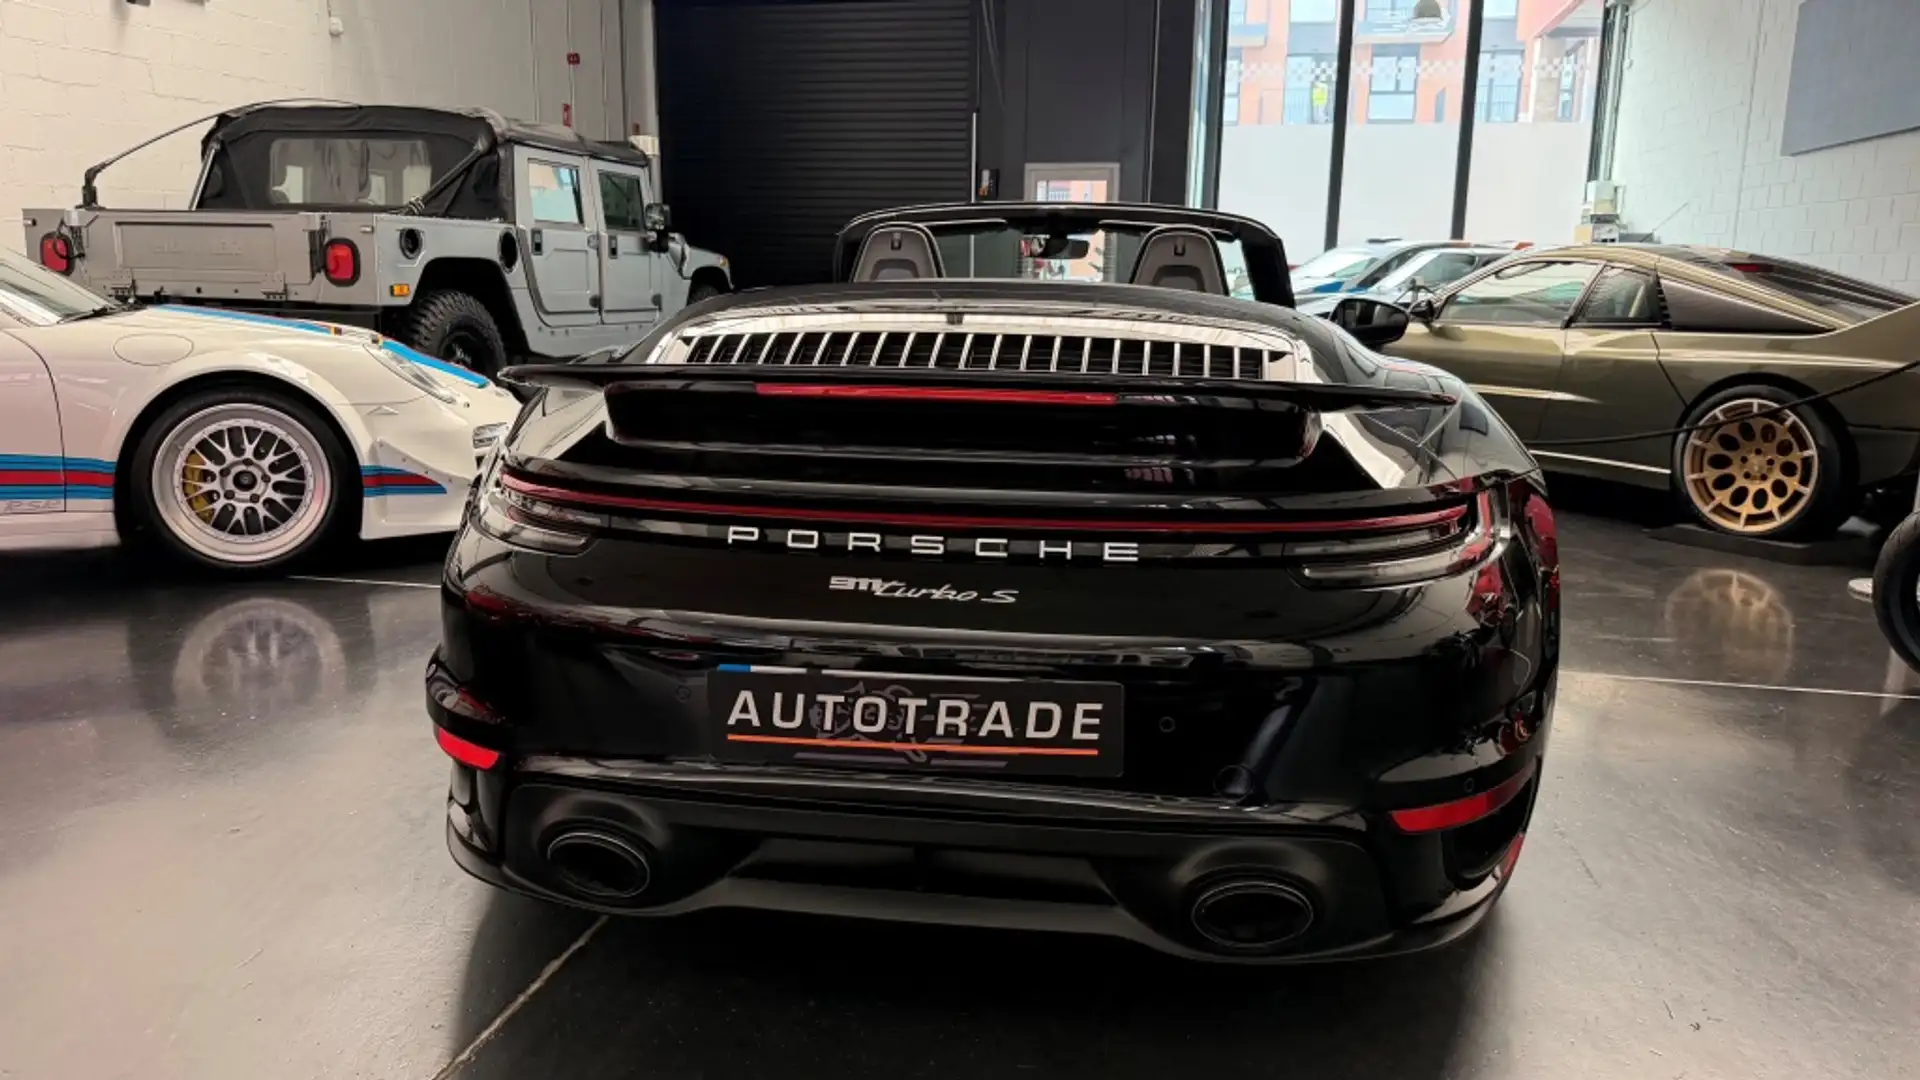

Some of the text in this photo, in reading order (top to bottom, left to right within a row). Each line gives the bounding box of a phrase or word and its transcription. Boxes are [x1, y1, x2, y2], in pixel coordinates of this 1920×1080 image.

[727, 525, 1139, 561] PORSCHE
[873, 580, 978, 601] turbo
[980, 590, 1019, 603] S
[727, 689, 1104, 740] AUTOTRADE
